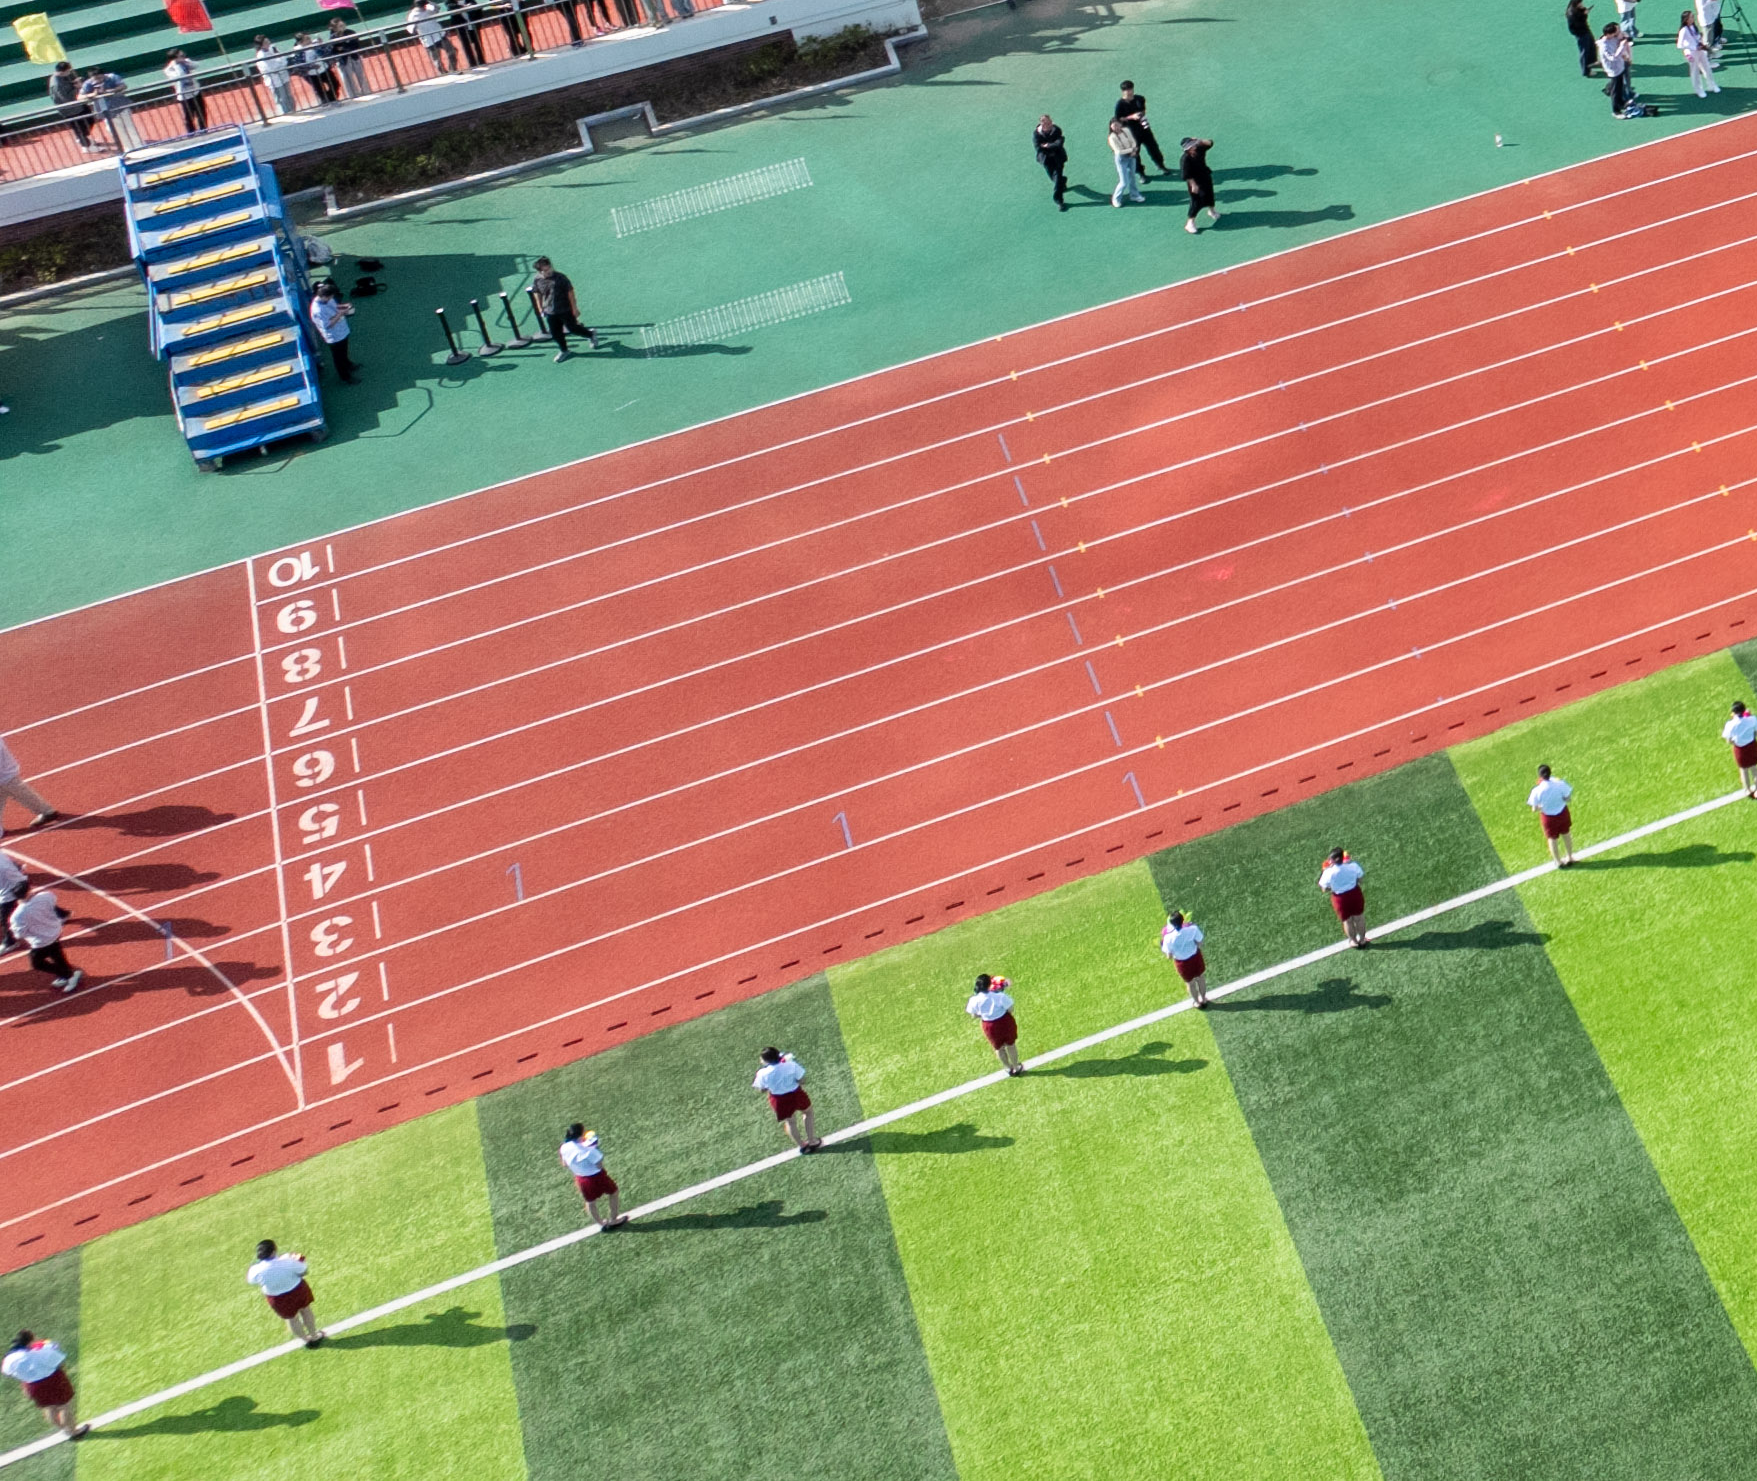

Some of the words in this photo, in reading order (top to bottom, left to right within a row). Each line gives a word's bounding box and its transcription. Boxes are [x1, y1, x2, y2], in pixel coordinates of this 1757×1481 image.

[268, 549, 321, 588] 10
[281, 648, 322, 684] 8
[289, 696, 330, 738] 7
[298, 802, 340, 845] 5
[303, 861, 347, 900] 4
[309, 915, 354, 958] 3
[315, 971, 362, 1020] 2
[327, 1042, 365, 1086] 1
